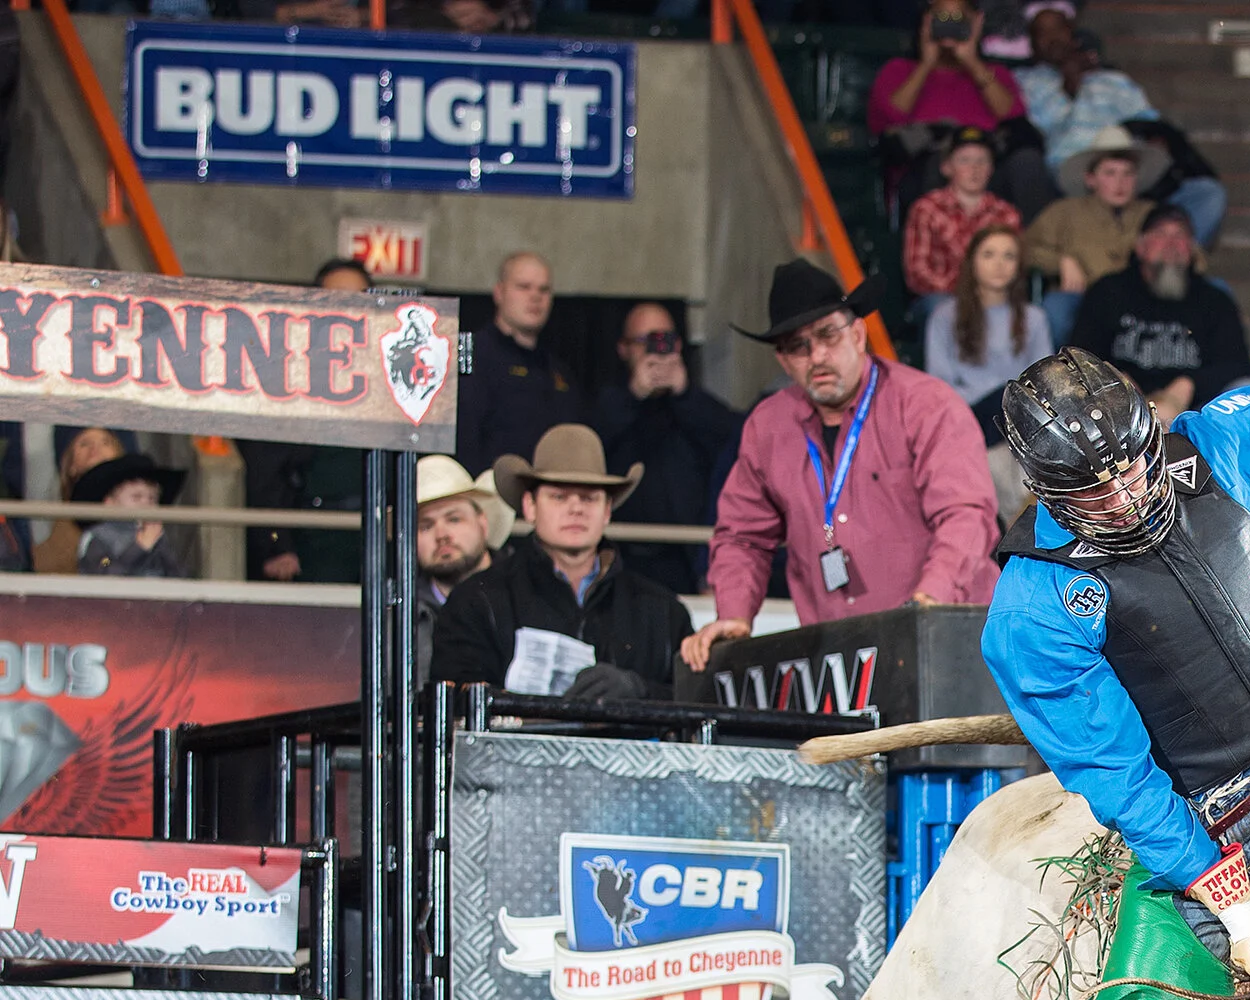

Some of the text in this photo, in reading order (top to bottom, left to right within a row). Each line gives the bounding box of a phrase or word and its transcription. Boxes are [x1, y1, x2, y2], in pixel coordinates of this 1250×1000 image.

[154, 65, 602, 150] BUD LIGHT
[350, 227, 423, 276] EXIT
[0, 287, 369, 405] YENNE
[141, 873, 247, 893] The REAL
[639, 864, 764, 911] CBR
[1202, 855, 1245, 892] TIFFAN
[113, 891, 279, 917] Cowboy Sport
[563, 949, 783, 988] The Road to Cheyenne
